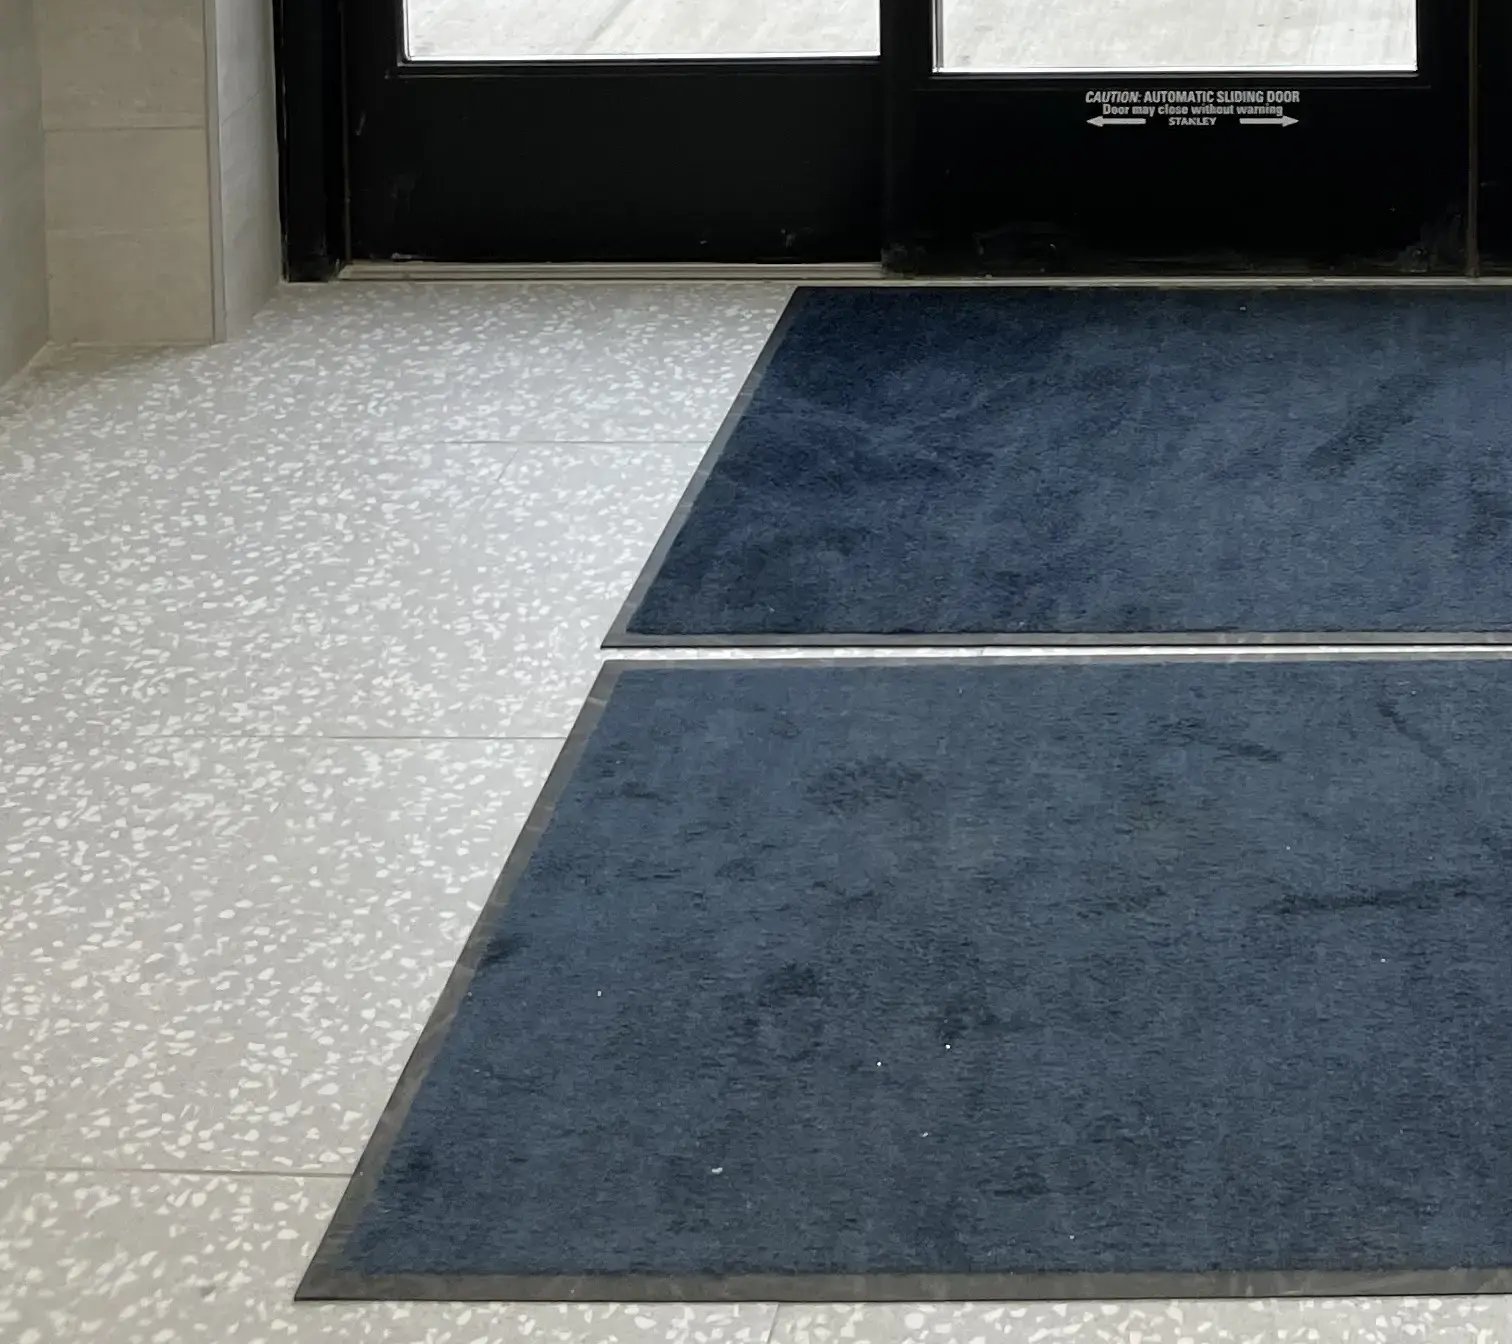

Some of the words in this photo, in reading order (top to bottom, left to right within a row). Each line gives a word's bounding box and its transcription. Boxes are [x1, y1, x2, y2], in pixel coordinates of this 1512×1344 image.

[1085, 91, 1142, 103] CAUTION:
[1144, 91, 1214, 103] AUTOMATIC
[1216, 91, 1264, 103] SLIDING
[1266, 91, 1300, 103] DOOR
[1102, 103, 1129, 114] Door
[1132, 106, 1155, 117] may
[1157, 103, 1188, 114] close
[1191, 103, 1234, 114] without
[1236, 104, 1284, 116] warning
[1168, 117, 1217, 126] STANLEY
